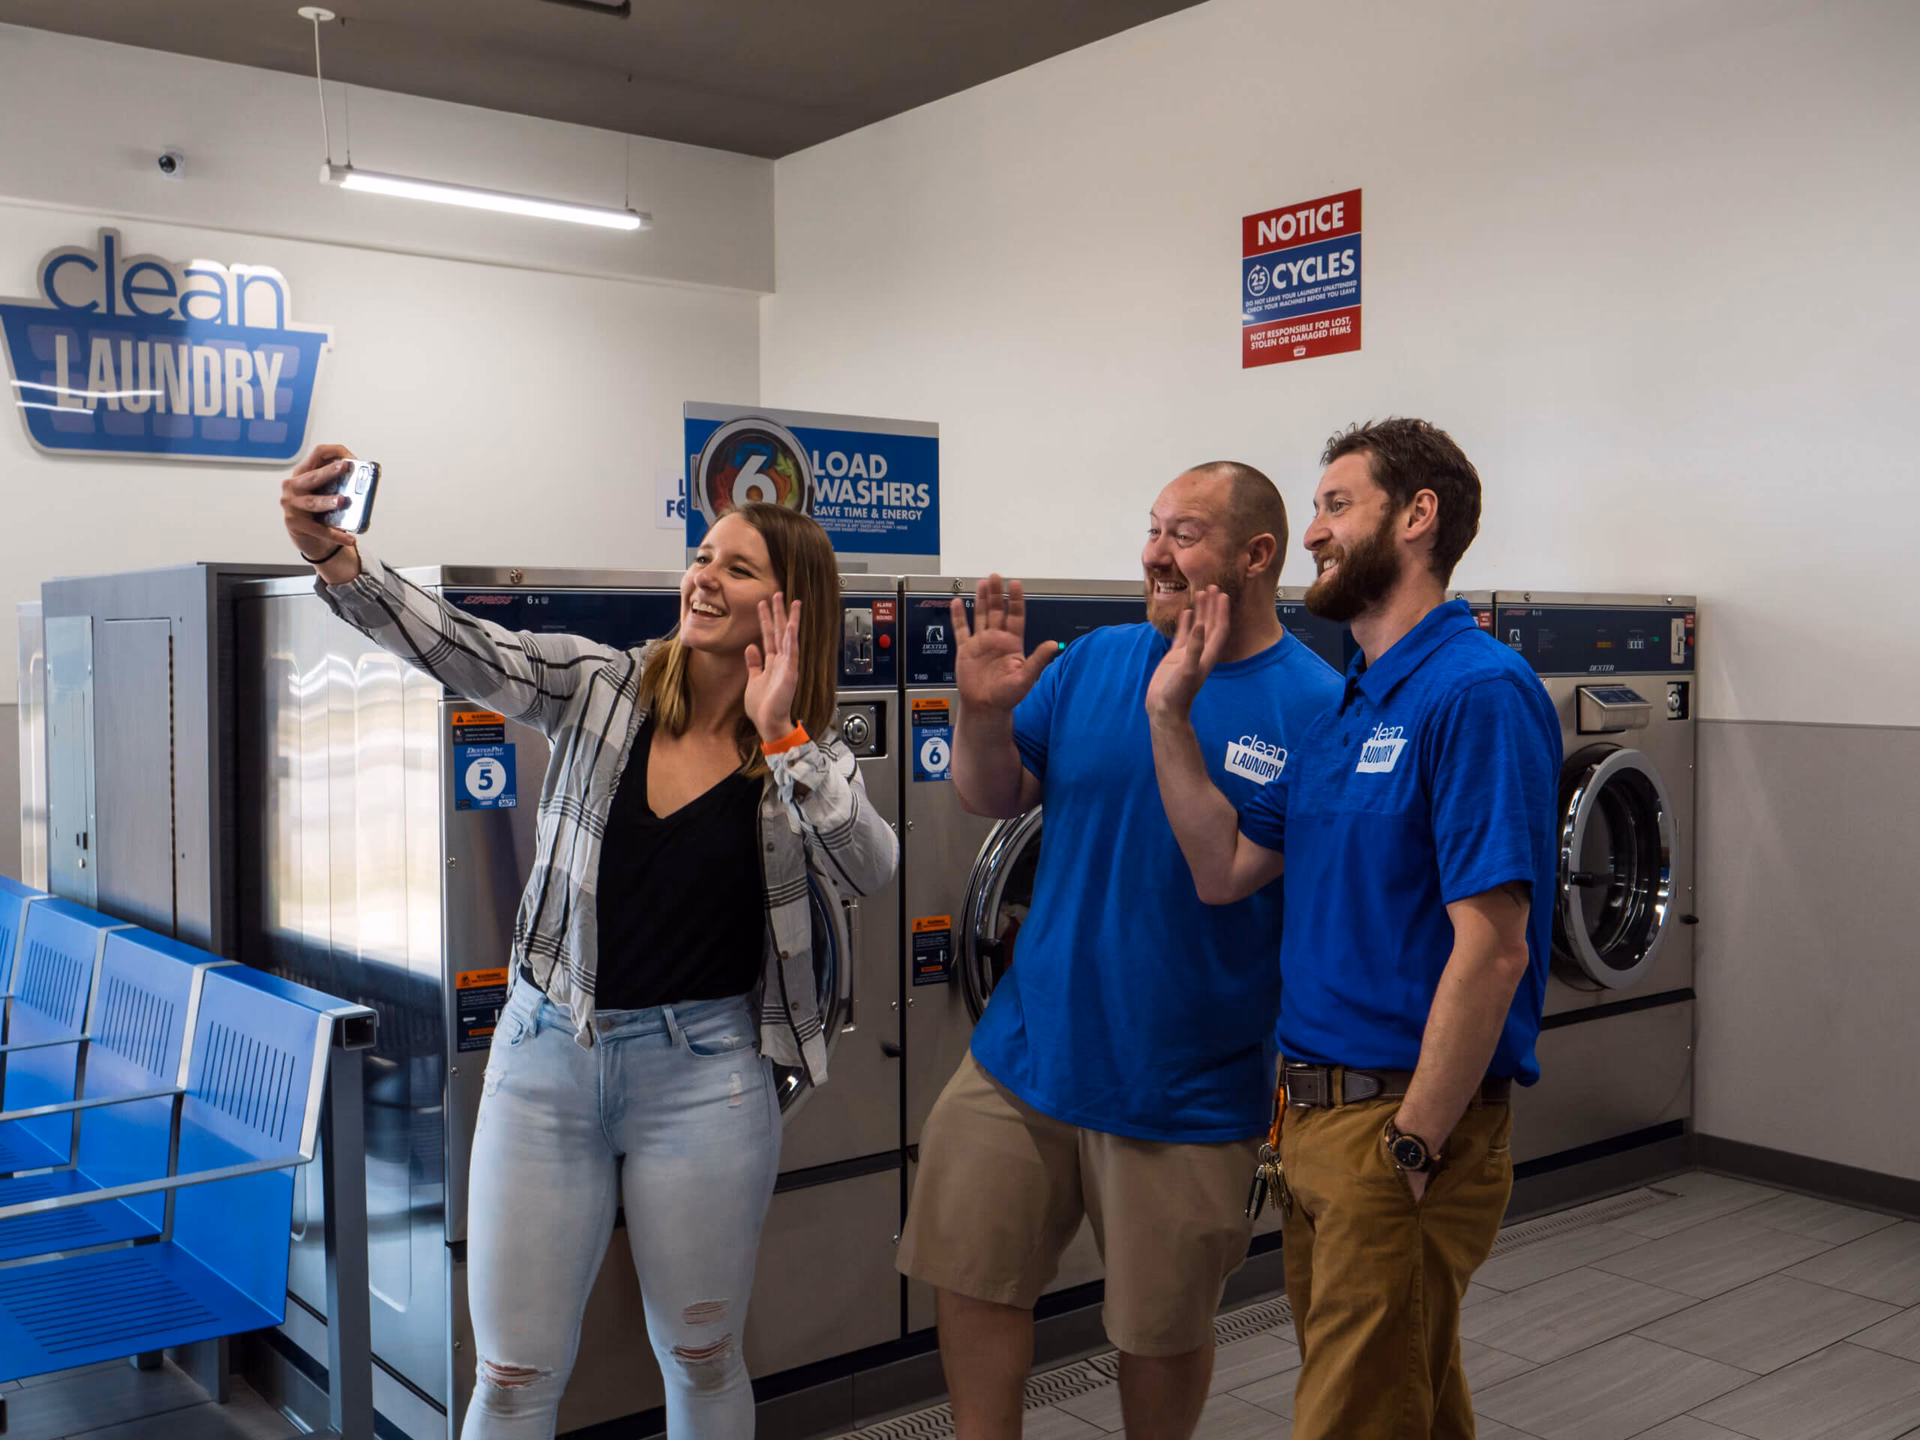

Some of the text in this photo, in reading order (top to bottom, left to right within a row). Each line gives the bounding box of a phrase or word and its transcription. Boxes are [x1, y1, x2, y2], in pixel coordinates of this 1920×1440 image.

[1258, 201, 1344, 246] NOTICE
[43, 235, 285, 330] clean
[1251, 272, 1266, 287] 25
[1272, 249, 1355, 289] CYCLES
[1245, 280, 1357, 308] DO NOT LEAVE YOUR LAUNDRY UNATTENDED
[1247, 286, 1356, 314] CHECK YOUR MACHINES BEFORE YOU LEAVE
[1250, 316, 1352, 341] NOT RESPONSIBLE FOR LOST,
[1251, 325, 1351, 350] STOLEN OR DAMAGED ITEMS
[55, 334, 284, 421] LAUNDRY
[813, 450, 888, 479] LOAD
[732, 454, 778, 505] 6
[814, 477, 930, 508] WASHERS
[814, 505, 923, 521] SAVE TIME & ENERGY
[527, 596, 533, 605] 6
[965, 600, 971, 608] 6
[929, 746, 942, 765] 6
[1239, 734, 1288, 764] clean
[1360, 744, 1396, 764] AUNDRY
[1232, 750, 1282, 780] LAUNDRY
[478, 768, 494, 791] 5
